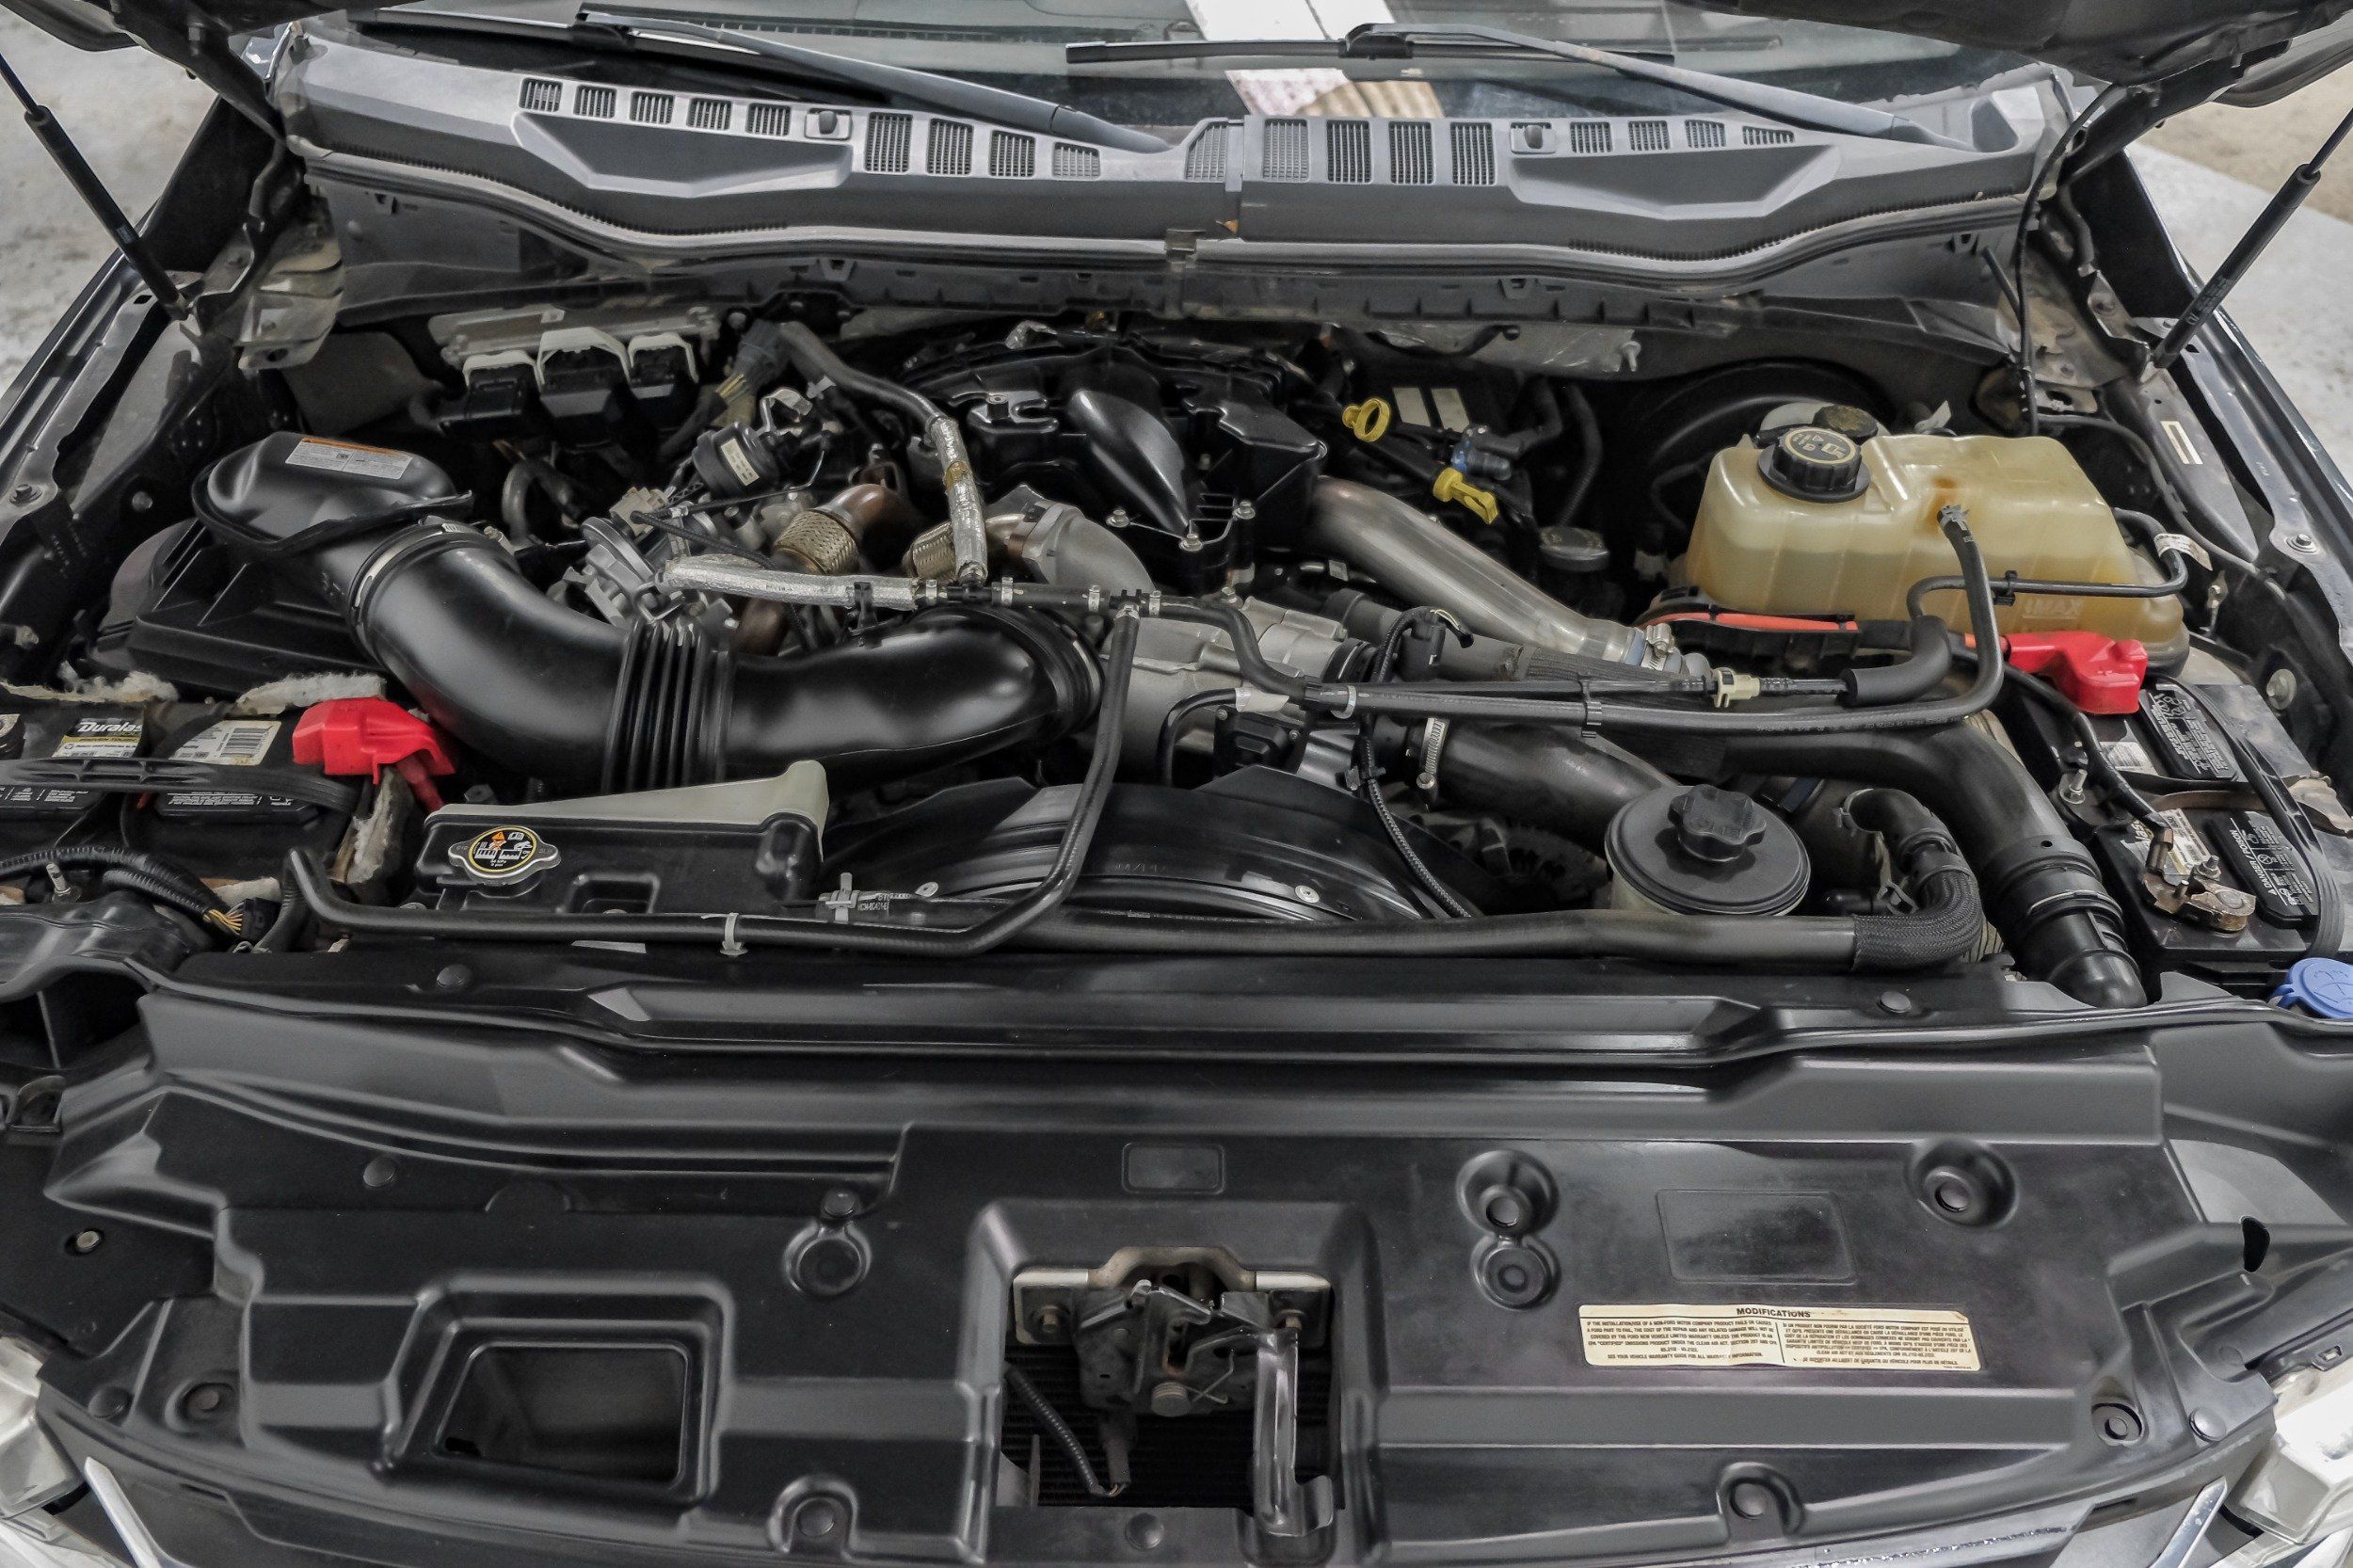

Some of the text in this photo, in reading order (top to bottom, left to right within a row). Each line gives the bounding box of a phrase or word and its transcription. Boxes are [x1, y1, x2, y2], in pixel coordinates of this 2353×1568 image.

[77, 721, 142, 732] Duralas
[2229, 829, 2250, 856] POISON
[2249, 860, 2272, 888] DANGER
[1737, 1307, 1810, 1318] MODIFICATIONS
